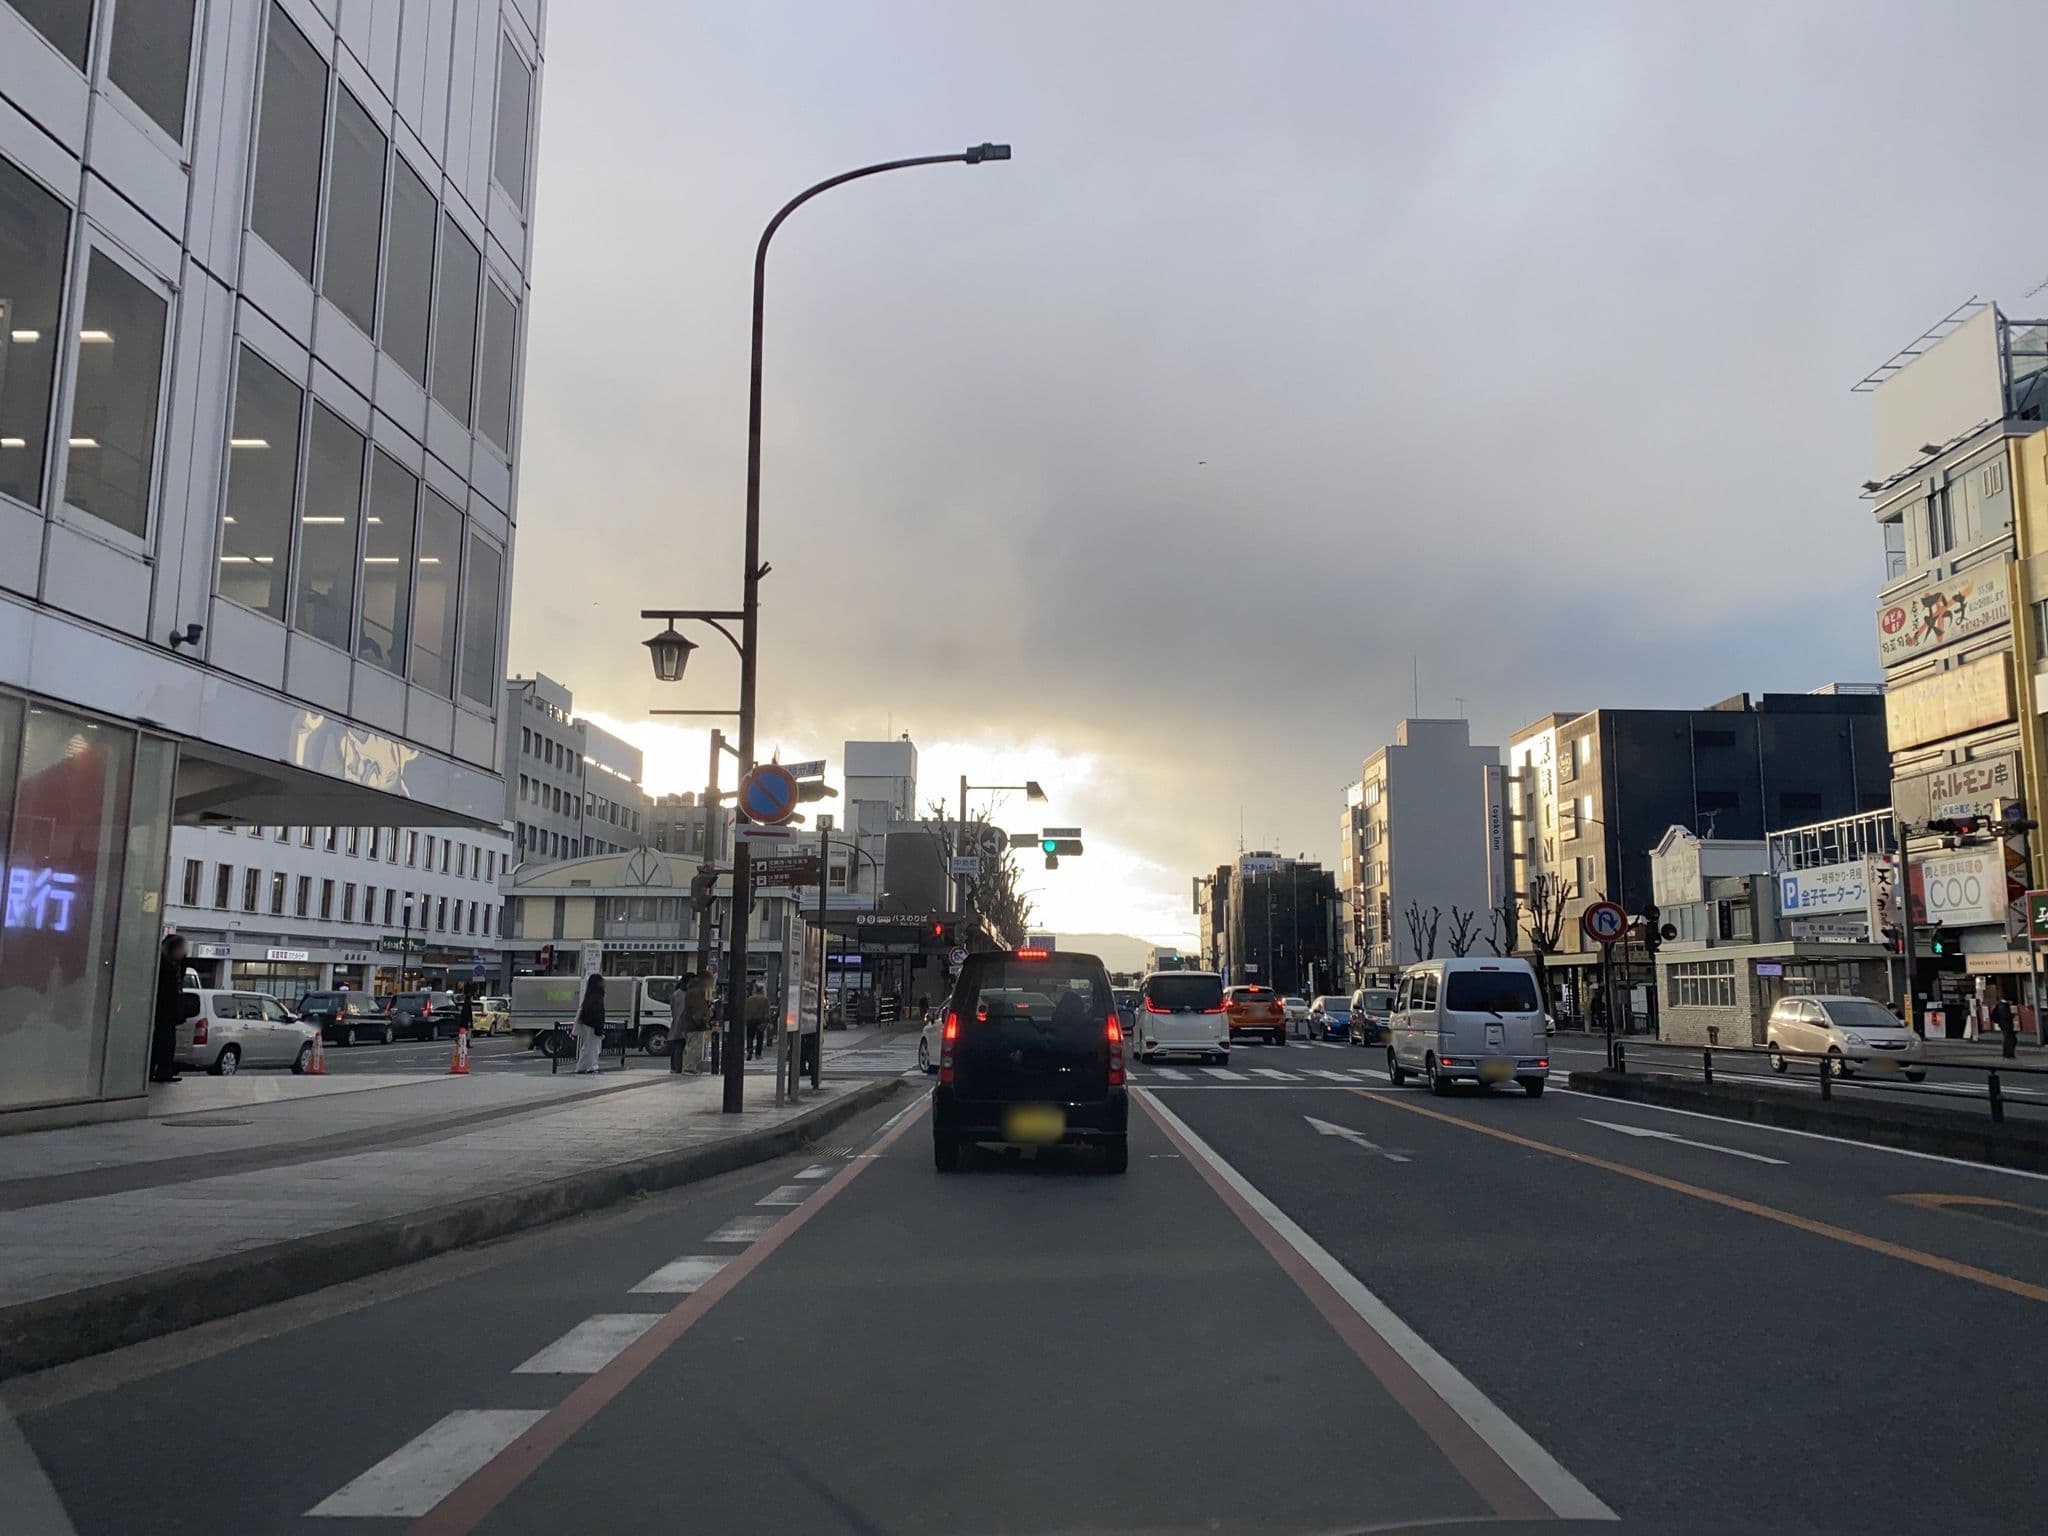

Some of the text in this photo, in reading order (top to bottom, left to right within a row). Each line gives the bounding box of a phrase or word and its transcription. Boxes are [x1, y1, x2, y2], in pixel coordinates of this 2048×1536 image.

[1932, 762, 2008, 800] ホルモン串
[1801, 884, 1867, 907] 金子モータープ
[1930, 875, 1981, 909] COO
